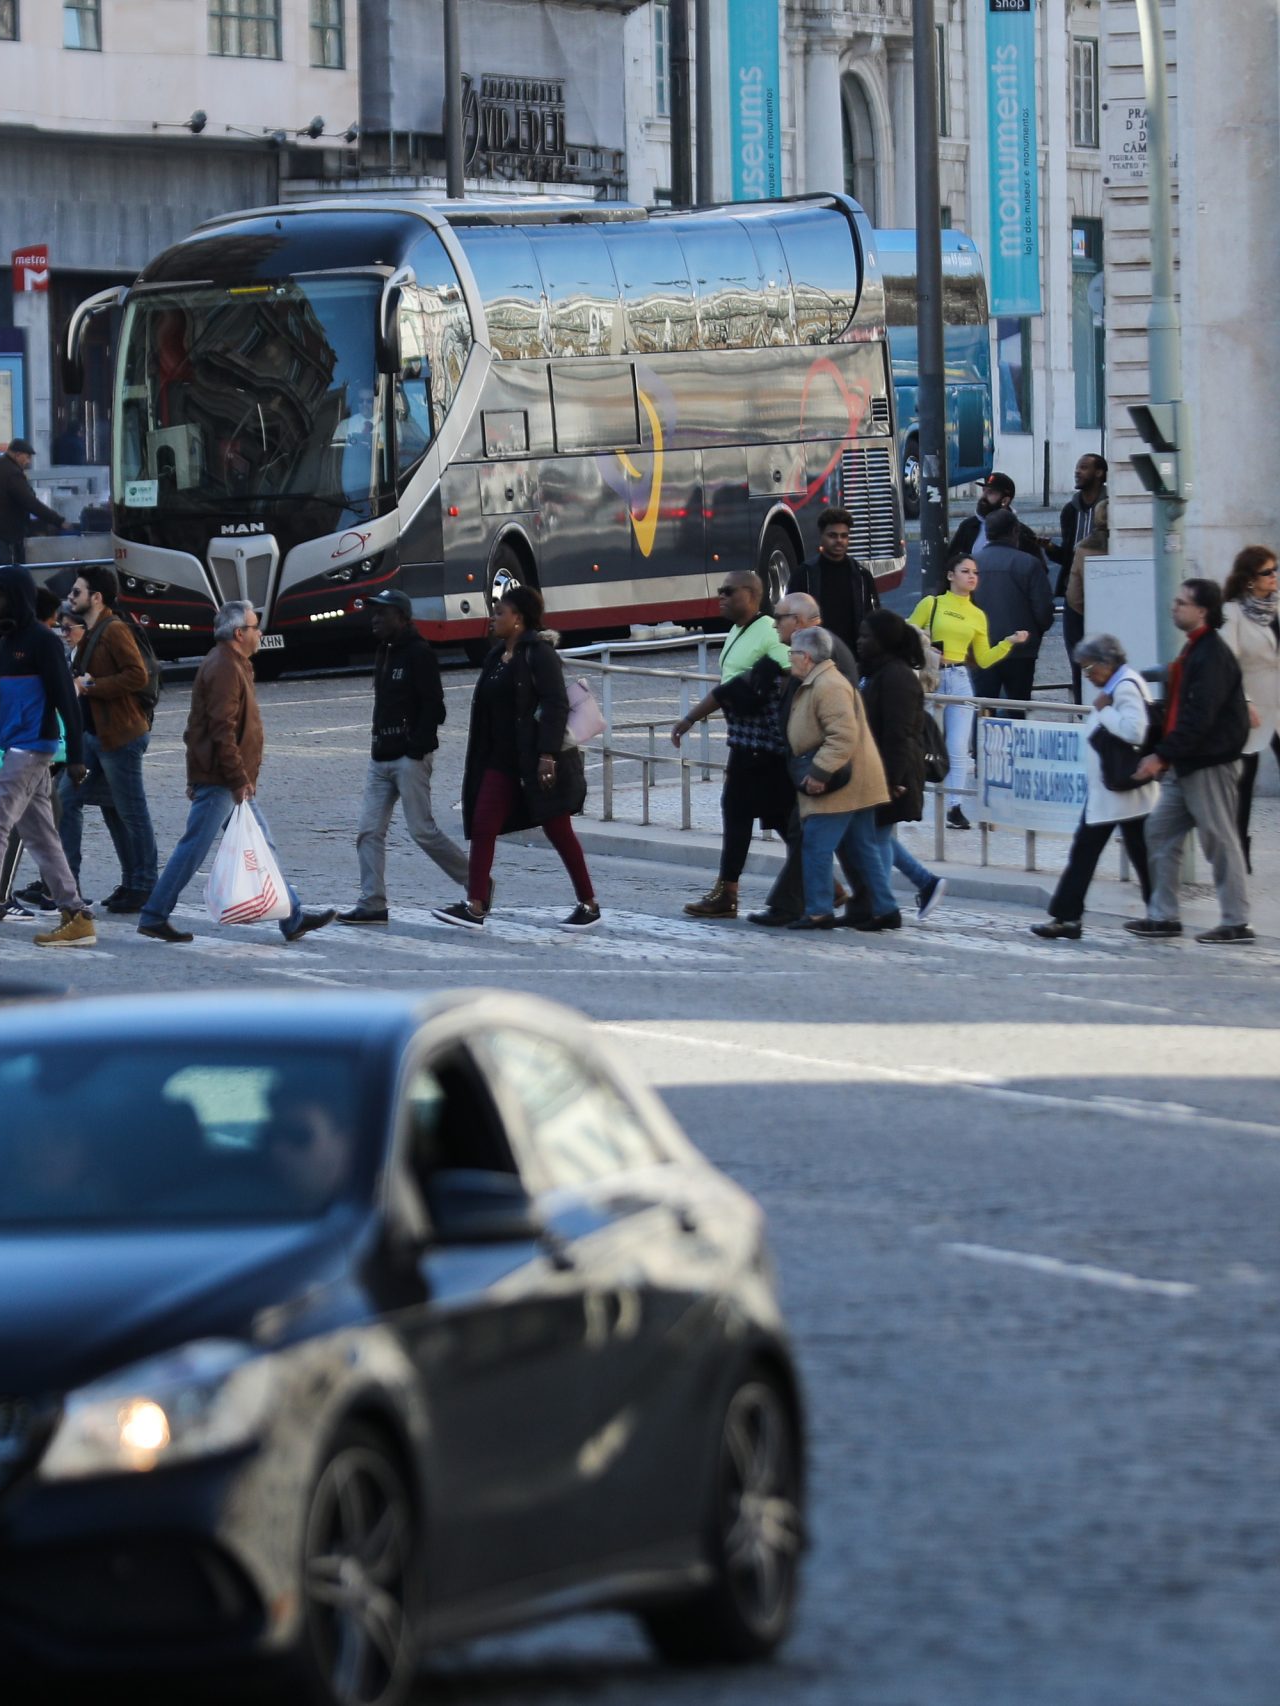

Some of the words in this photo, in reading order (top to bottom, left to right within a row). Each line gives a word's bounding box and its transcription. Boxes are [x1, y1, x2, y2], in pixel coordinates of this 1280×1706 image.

[766, 87, 775, 149] monumentos
[992, 43, 1020, 257] monuments
[15, 254, 47, 265] metro
[221, 522, 264, 534] MAN
[1014, 727, 1035, 758] PELO
[1039, 729, 1078, 761] AUMENTO
[1015, 768, 1031, 799] DOS
